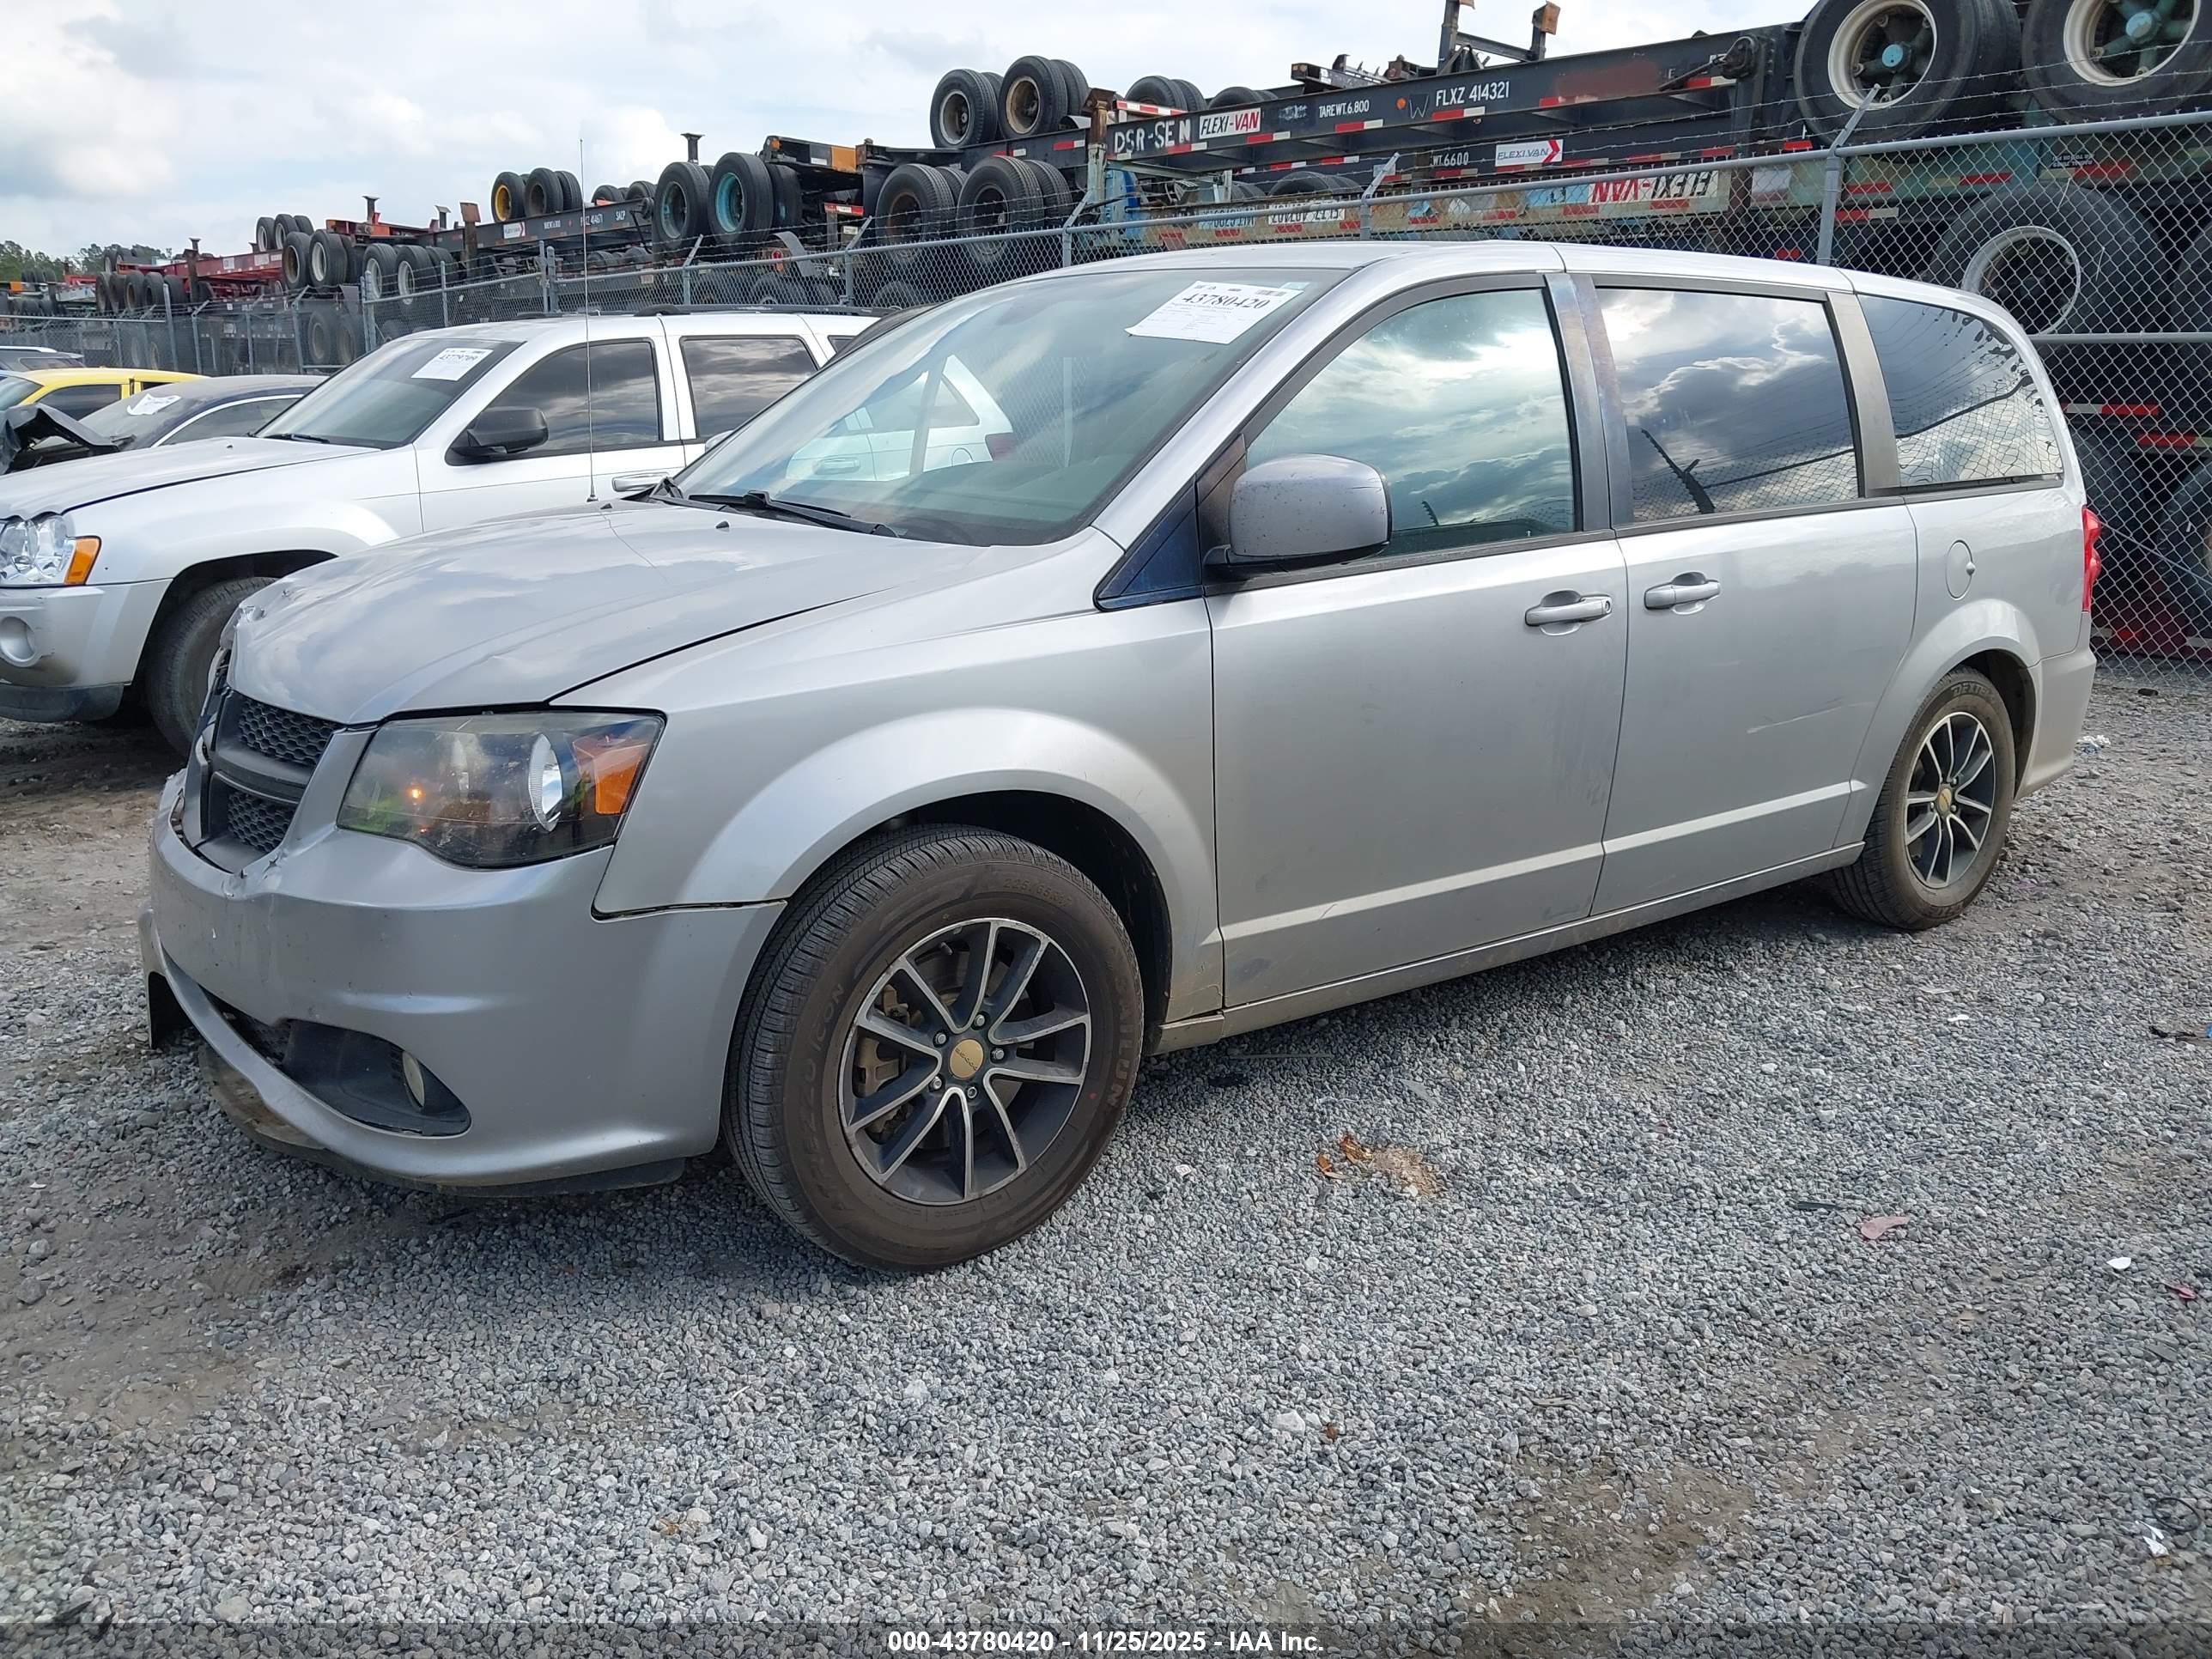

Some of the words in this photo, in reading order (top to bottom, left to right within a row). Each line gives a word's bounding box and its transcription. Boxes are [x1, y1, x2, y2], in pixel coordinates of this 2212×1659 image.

[1436, 88, 1465, 106] FLXZ
[1468, 82, 1510, 101] 414321
[1201, 112, 1260, 136] FLEXI-VAN
[1182, 293, 1271, 309] 43780420
